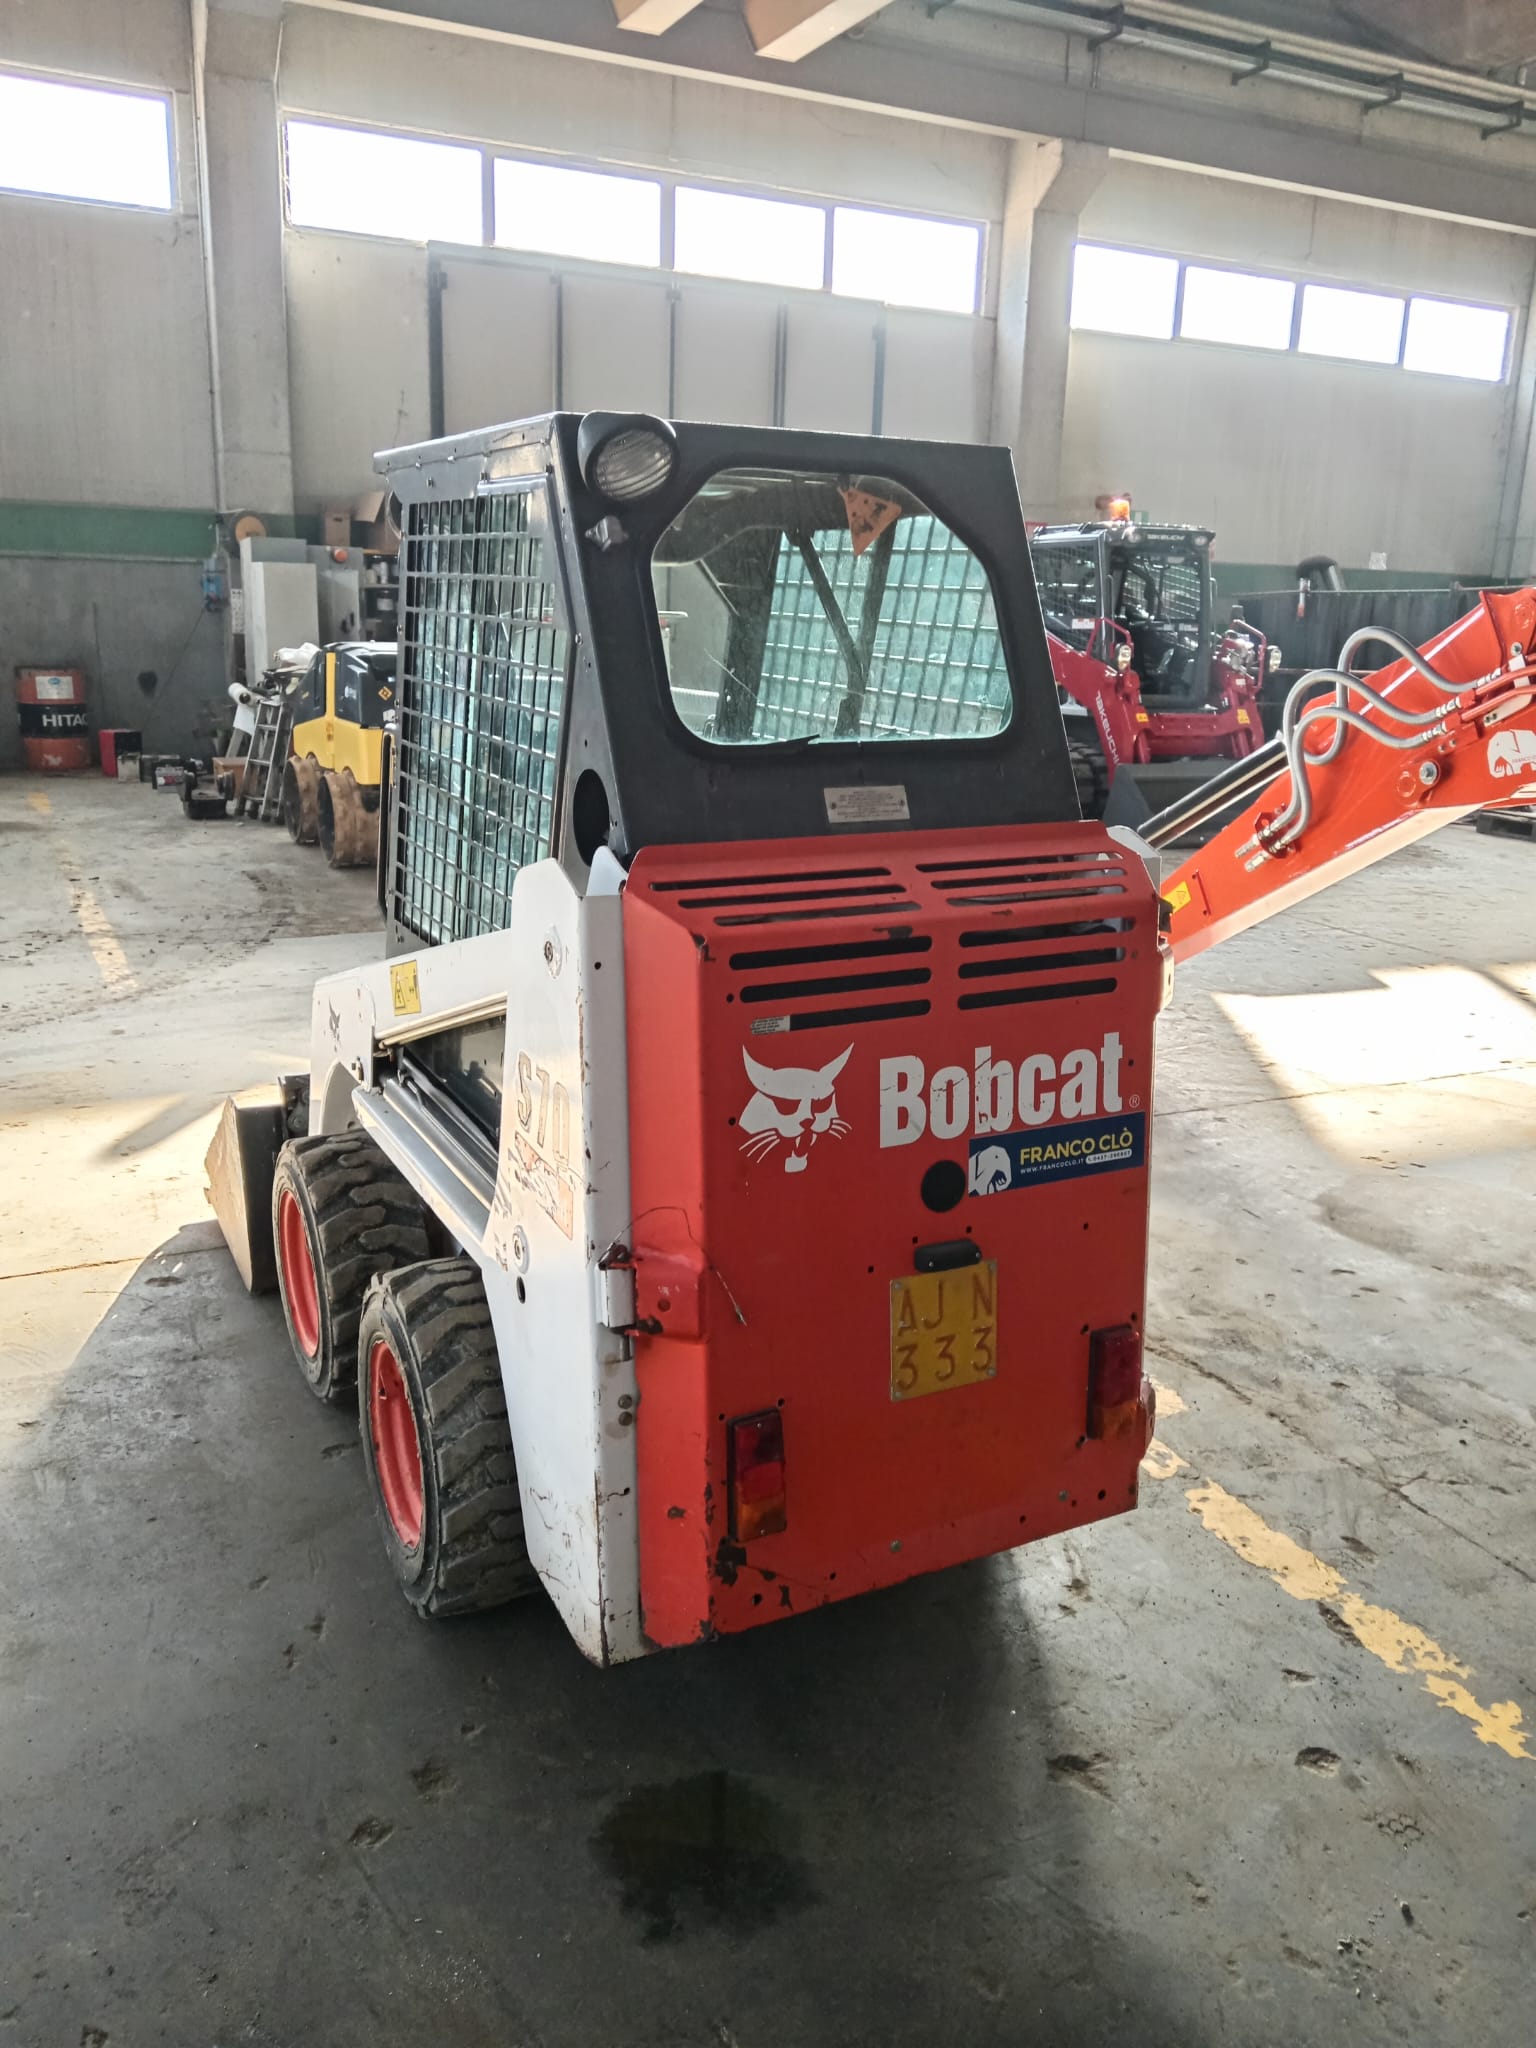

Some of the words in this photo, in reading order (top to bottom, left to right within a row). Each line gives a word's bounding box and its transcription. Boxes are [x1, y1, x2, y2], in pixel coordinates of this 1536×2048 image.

[517, 1051, 570, 1169] S70
[879, 1031, 1123, 1148] Bobcat
[1019, 1137, 1095, 1166] FRANCO
[1099, 1127, 1133, 1151] CLÒ
[896, 1325, 993, 1391] 333
